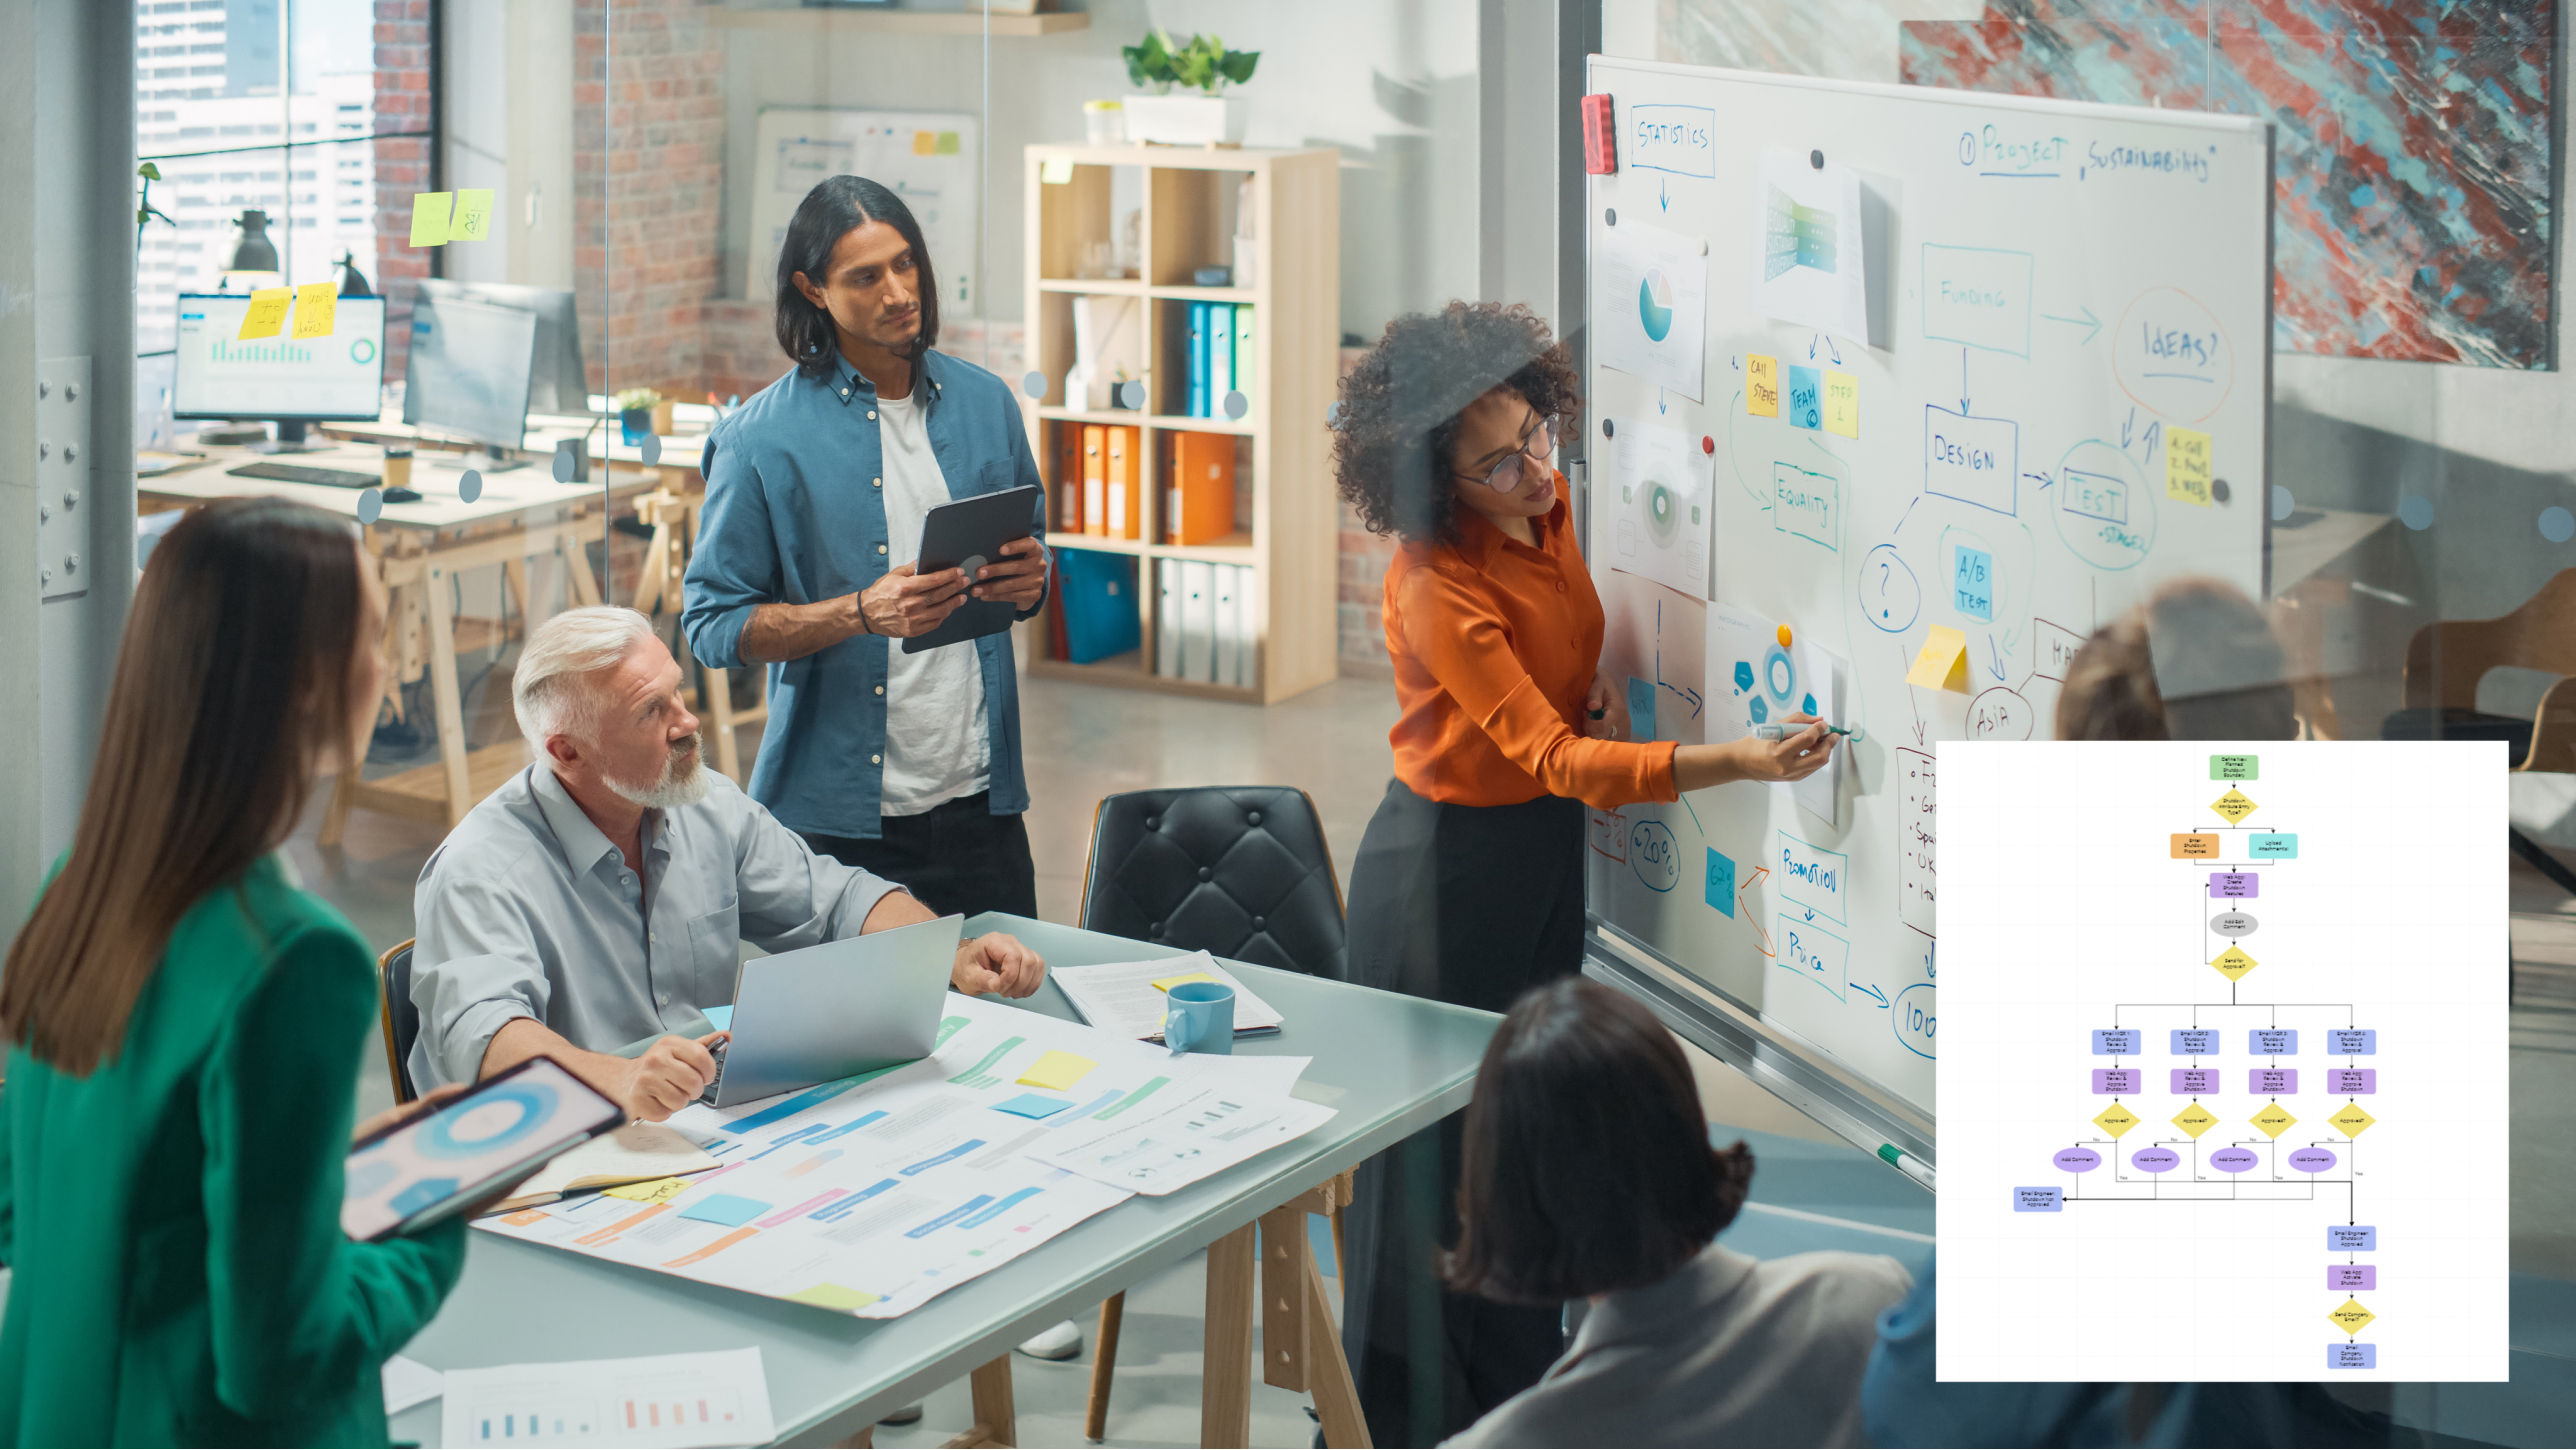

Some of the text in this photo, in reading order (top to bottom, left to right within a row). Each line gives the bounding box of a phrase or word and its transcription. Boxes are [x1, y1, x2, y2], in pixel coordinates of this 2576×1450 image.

[1791, 383, 1817, 411] TEAM
[2069, 476, 2122, 519] TEST
[1957, 554, 1985, 585] A/B
[810, 1079, 857, 1098] Testing
